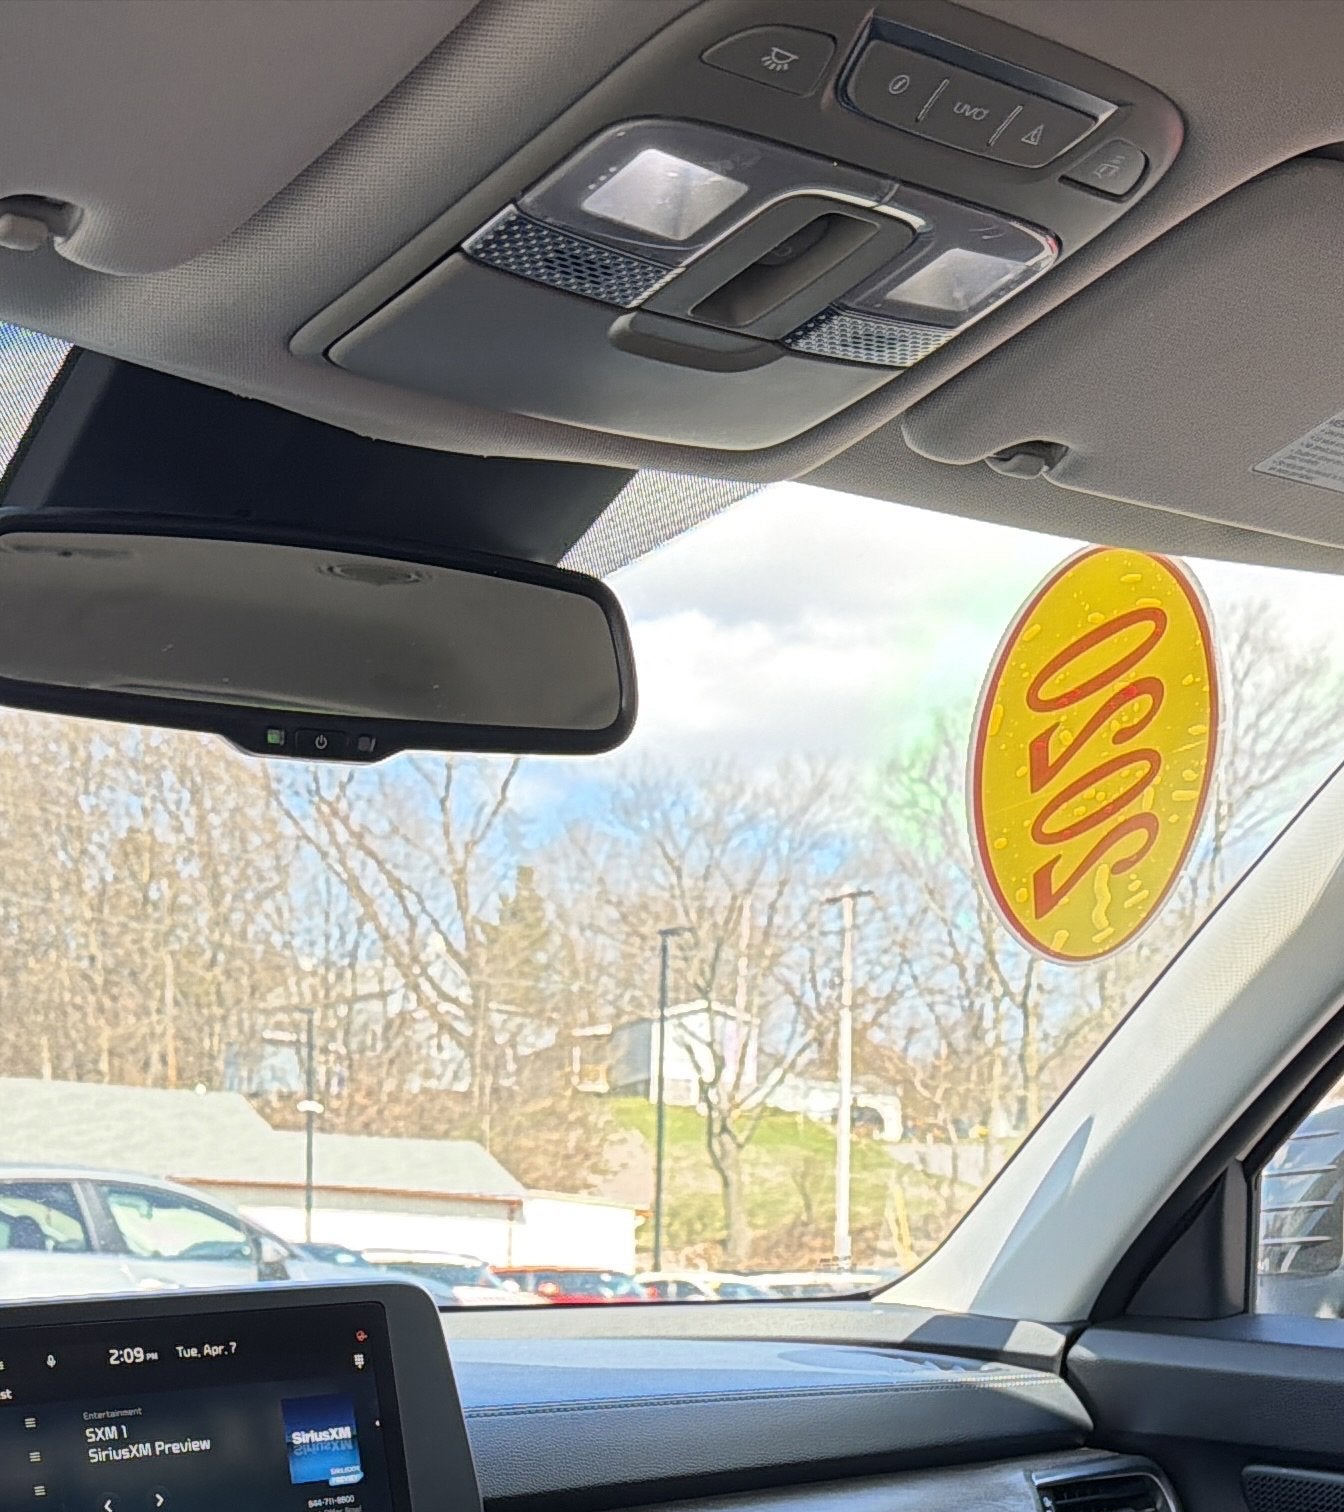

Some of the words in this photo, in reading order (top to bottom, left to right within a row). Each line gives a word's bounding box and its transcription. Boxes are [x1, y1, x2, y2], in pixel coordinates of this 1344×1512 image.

[109, 1347, 144, 1365] 2:09
[203, 1343, 228, 1357] Apr.
[229, 1341, 237, 1354] 7
[82, 1407, 143, 1421] Entertainment
[85, 1425, 119, 1443] SXM
[121, 1424, 128, 1439] 1
[291, 1426, 352, 1445] SiriusXM
[88, 1443, 152, 1464] SiriusXM
[155, 1438, 211, 1456] Preview
